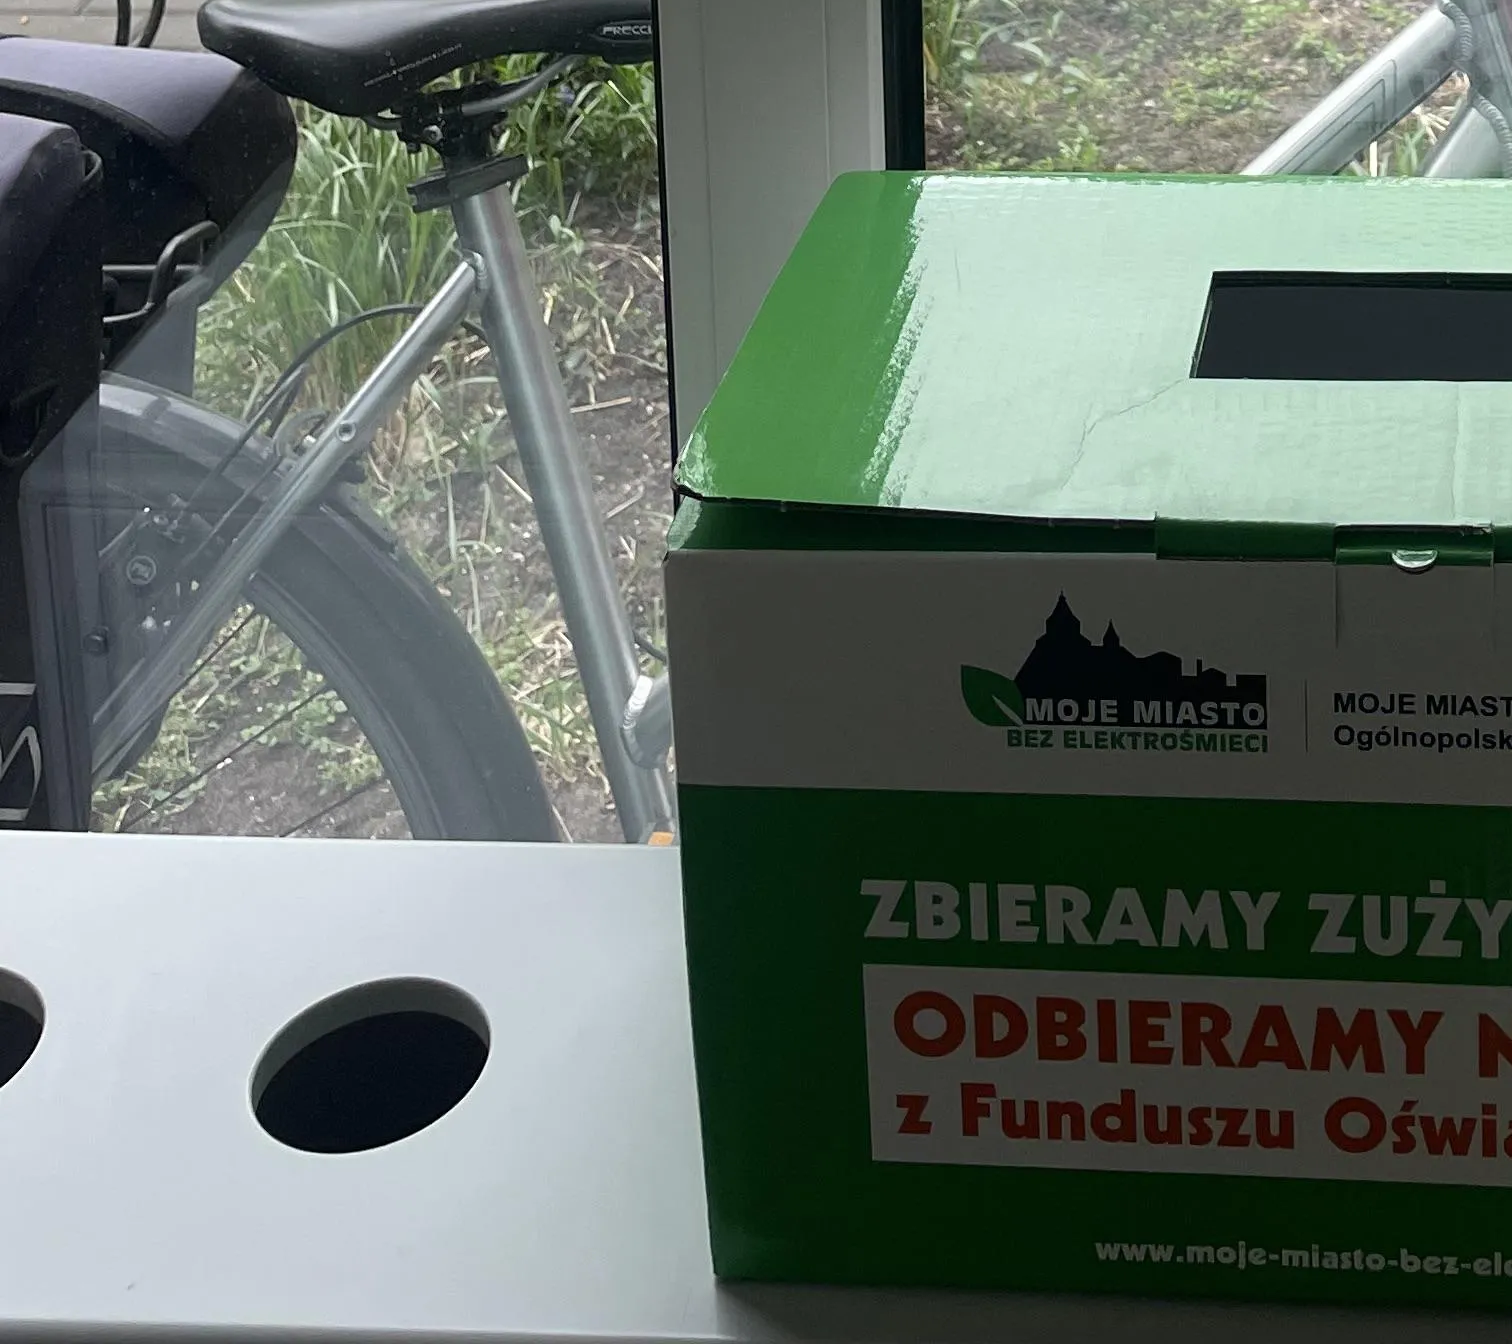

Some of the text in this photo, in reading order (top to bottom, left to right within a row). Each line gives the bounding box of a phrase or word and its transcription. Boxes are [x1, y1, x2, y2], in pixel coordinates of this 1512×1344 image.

[1025, 697, 1266, 727] MOJE MIASTO
[1333, 691, 1417, 716] MOJE
[1006, 728, 1269, 754] BEZ ELEKTROŚMIECI
[859, 878, 1281, 952] ZBIERAMY
[893, 989, 1445, 1076] ODBIERAMY
[896, 1094, 933, 1135] z
[960, 1082, 1296, 1150] Funduszu
